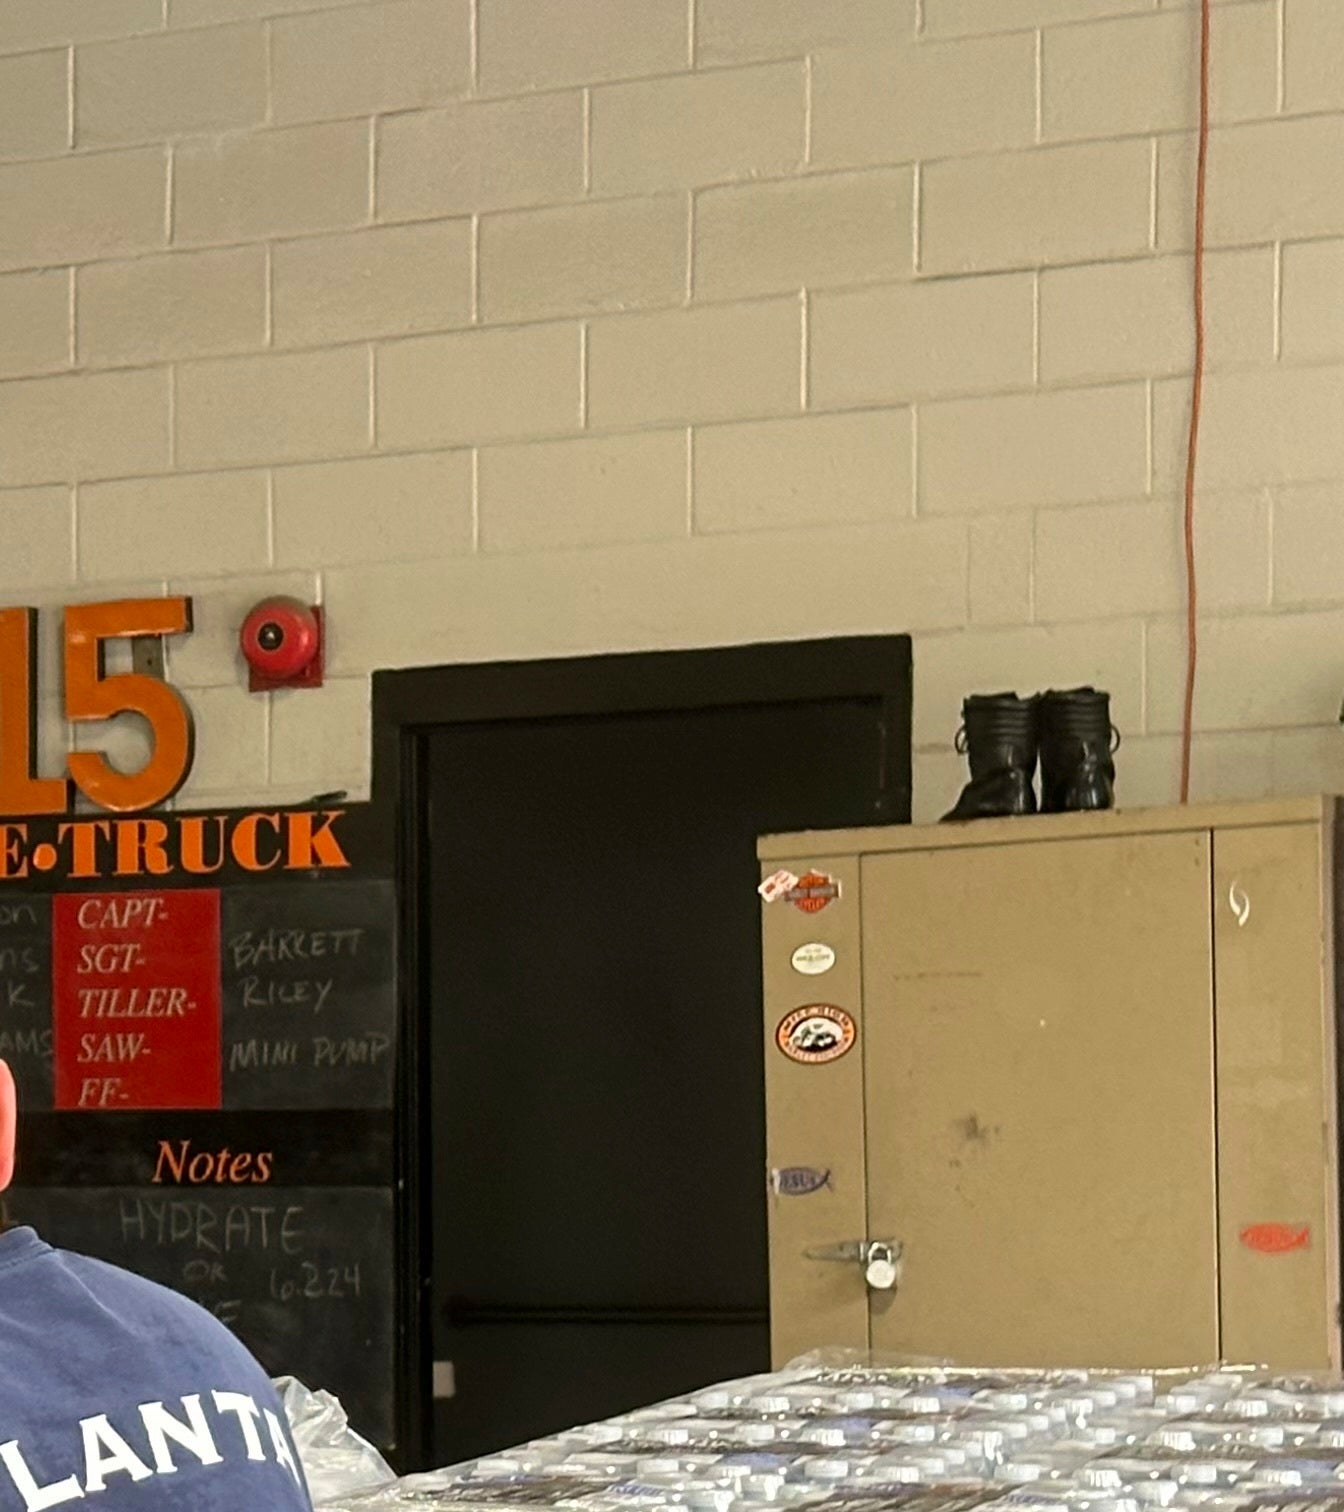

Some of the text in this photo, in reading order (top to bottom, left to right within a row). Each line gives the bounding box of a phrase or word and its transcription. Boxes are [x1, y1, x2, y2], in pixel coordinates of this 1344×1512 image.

[58, 811, 351, 878] TRUCK
[76, 897, 169, 929] CAPT-
[76, 944, 146, 974] SGT-
[77, 988, 197, 1018] TILLER-
[76, 1033, 151, 1063] SAW-
[229, 1032, 391, 1072] MINI PUMP
[151, 1140, 273, 1183] Notes
[118, 1199, 306, 1254] HYDRATE
